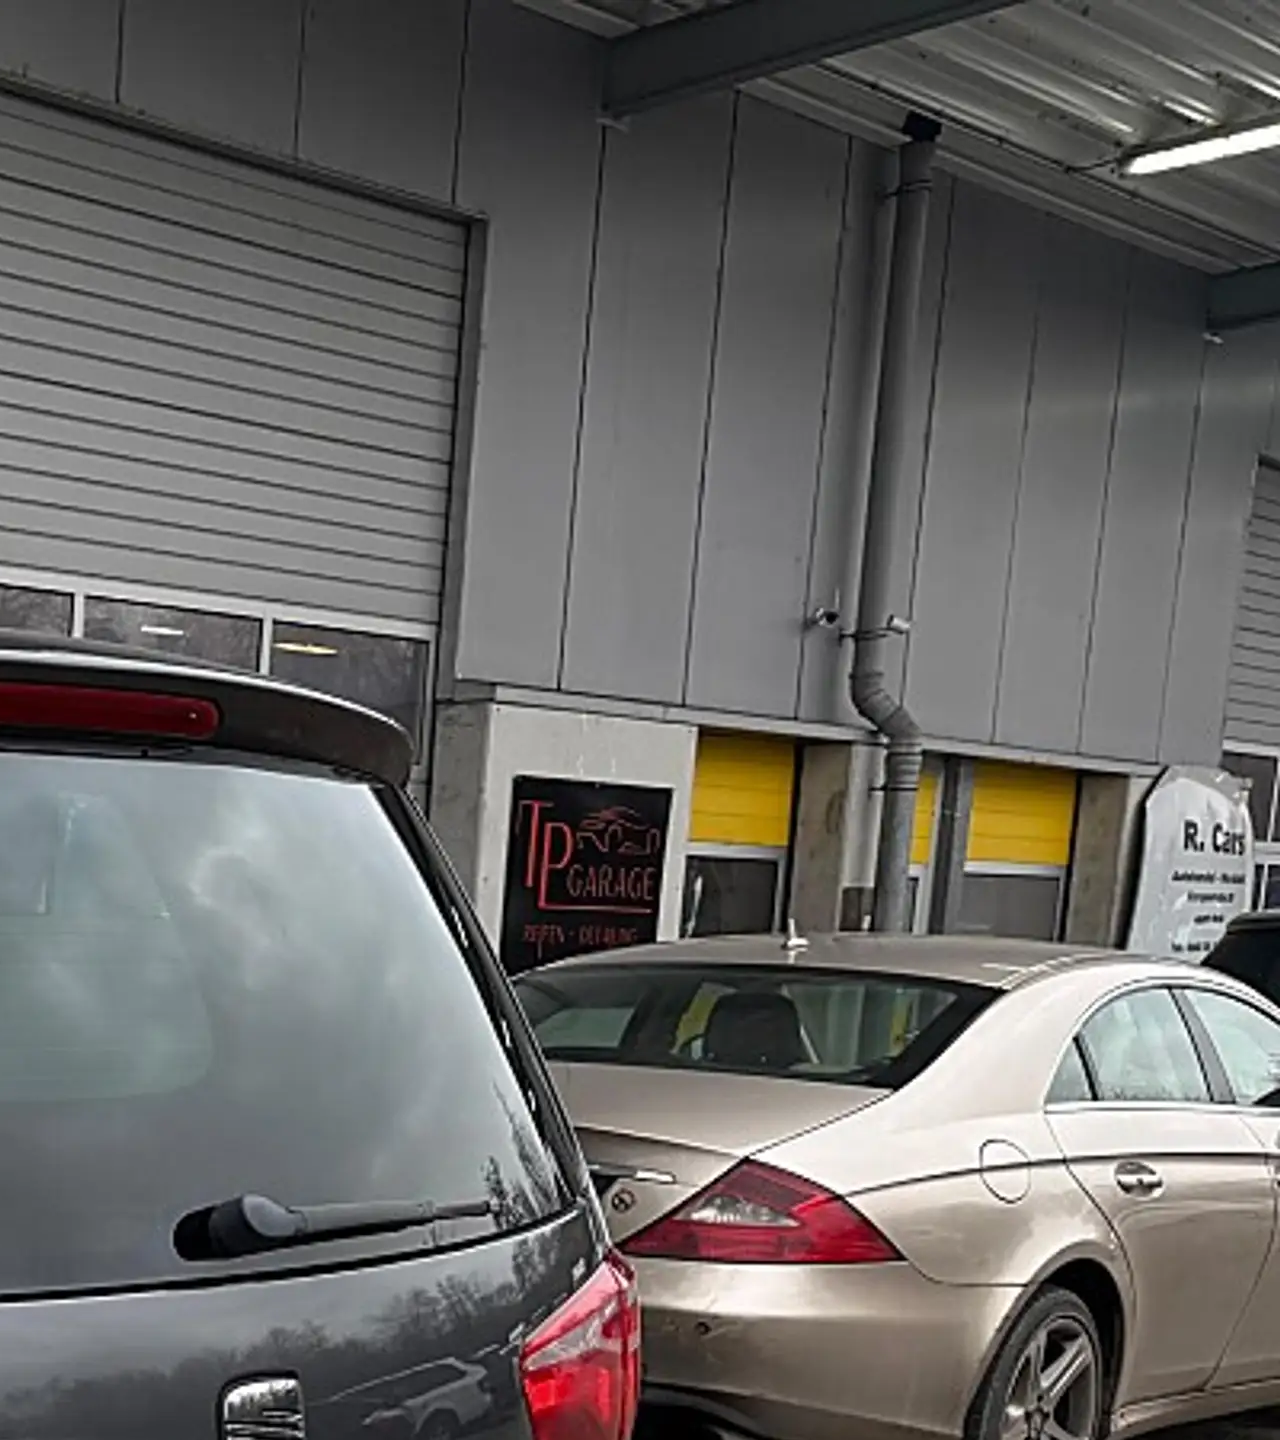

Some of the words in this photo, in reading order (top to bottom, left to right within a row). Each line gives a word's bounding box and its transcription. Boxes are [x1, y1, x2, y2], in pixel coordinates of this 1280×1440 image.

[1183, 819, 1205, 852] R.
[1212, 822, 1245, 856] Cars
[566, 864, 657, 900] GARAGE
